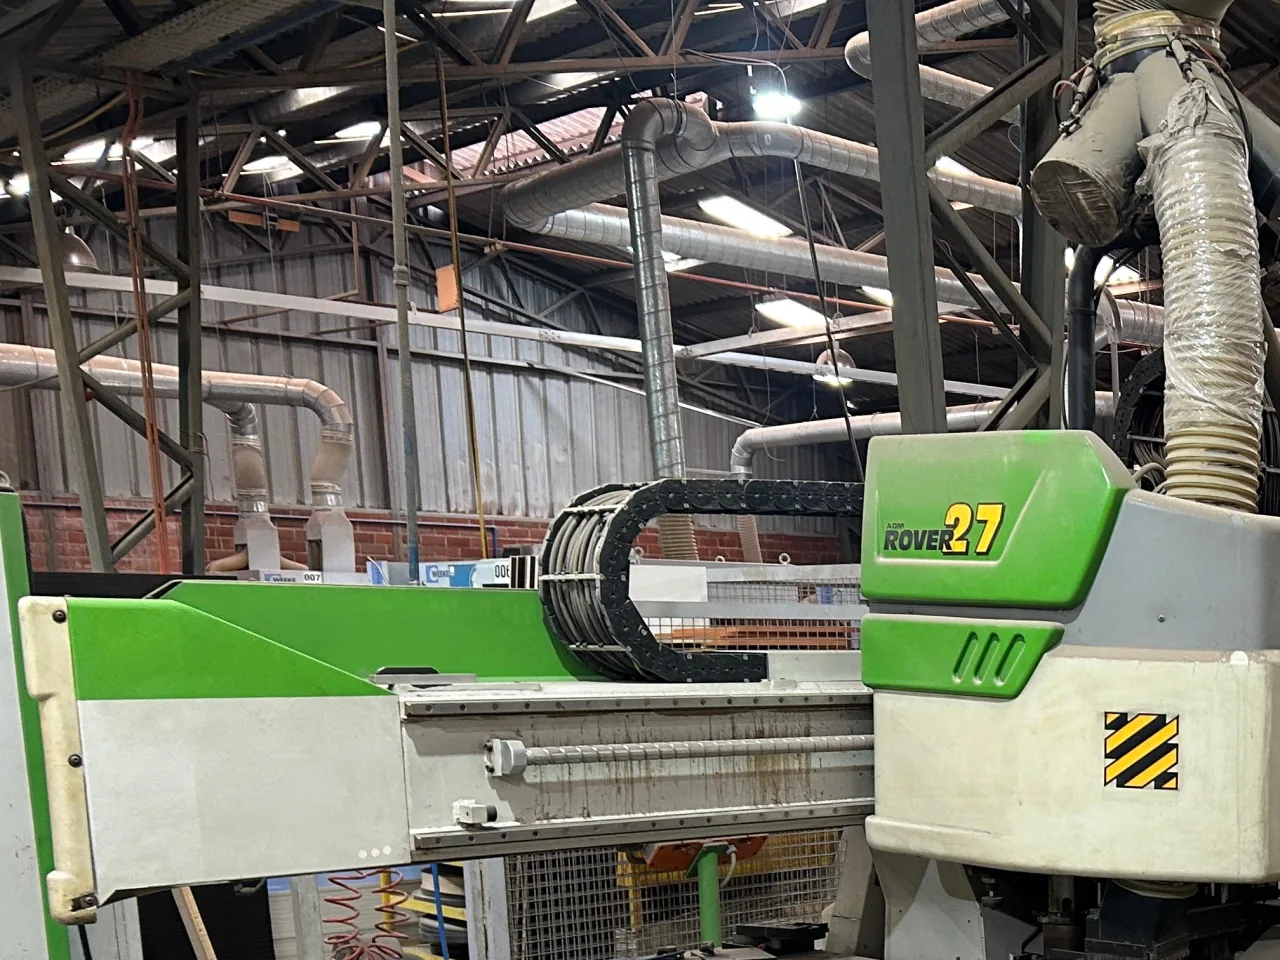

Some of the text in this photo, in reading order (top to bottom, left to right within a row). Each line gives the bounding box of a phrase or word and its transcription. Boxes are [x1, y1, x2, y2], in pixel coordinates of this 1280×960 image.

[884, 502, 1005, 555] ROVER 27
[304, 573, 320, 581] 007
